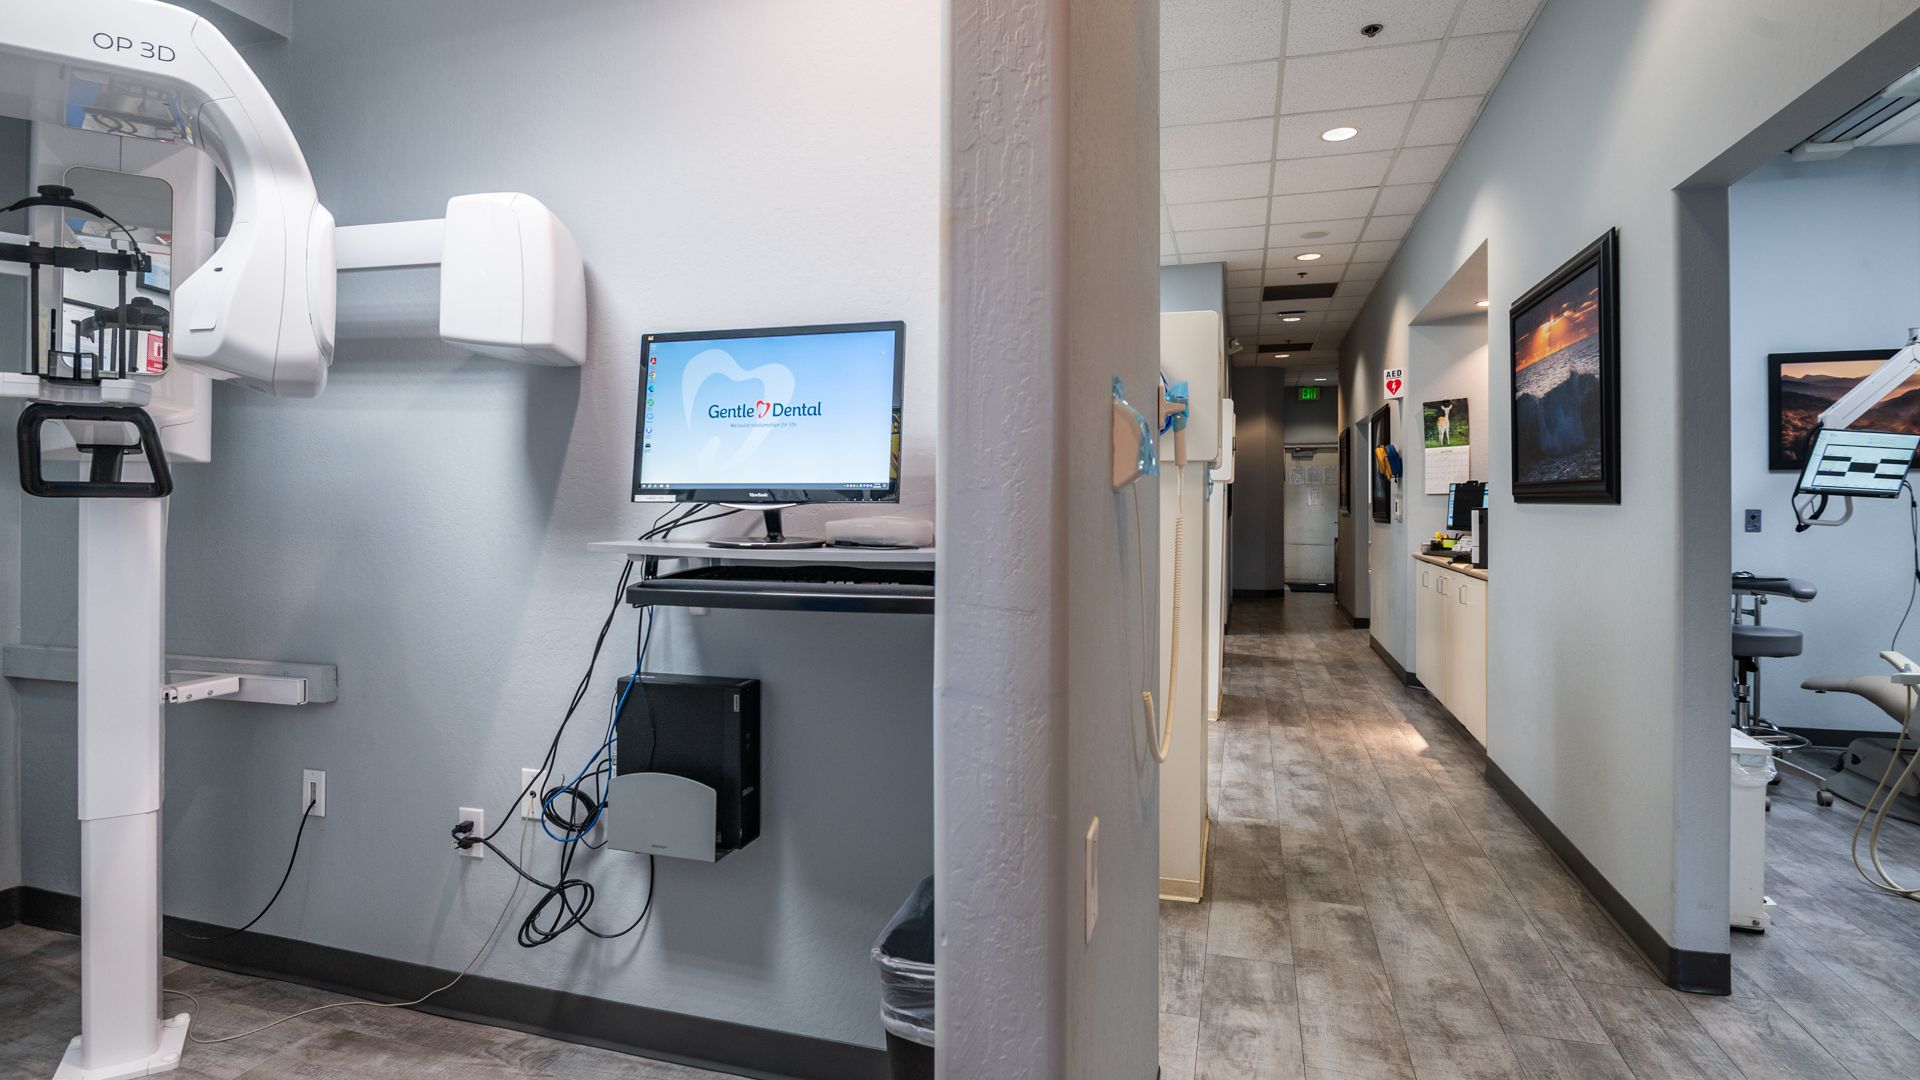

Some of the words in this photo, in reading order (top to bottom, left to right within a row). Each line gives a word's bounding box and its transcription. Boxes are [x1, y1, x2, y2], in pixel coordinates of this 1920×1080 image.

[93, 33, 133, 52] OP
[140, 42, 176, 62] 3D
[1386, 369, 1402, 378] AED
[1302, 387, 1317, 399] EXIT
[708, 403, 755, 419] Gentle
[772, 401, 822, 417] Dental
